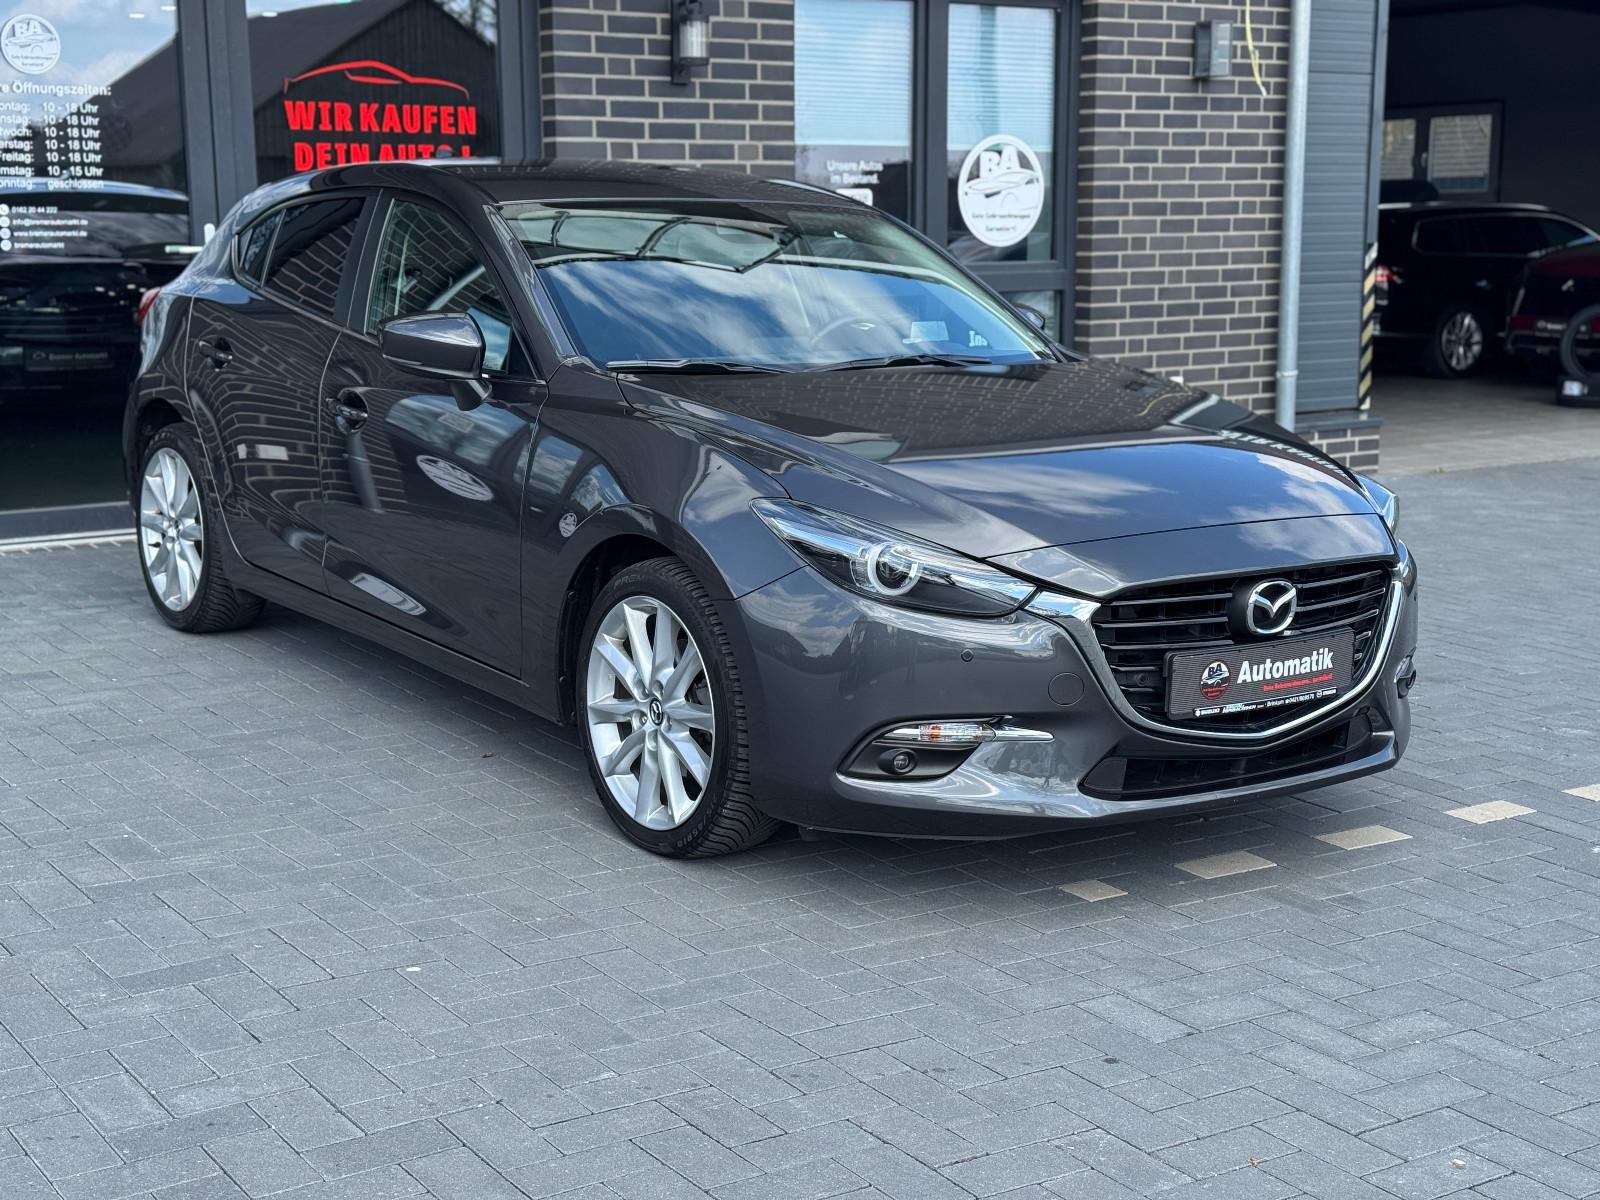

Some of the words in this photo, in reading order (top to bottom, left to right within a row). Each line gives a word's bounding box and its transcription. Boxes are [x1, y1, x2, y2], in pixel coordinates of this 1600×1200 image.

[13, 80, 112, 97] Öffnungszeiten:
[43, 102, 55, 112] 10
[66, 103, 78, 112] 18
[80, 103, 99, 113] Uhr
[44, 115, 56, 124] 10
[66, 115, 79, 125] 18
[80, 115, 100, 125] Uhr
[284, 100, 353, 132] WIR
[360, 103, 477, 135] KAUFEN
[44, 127, 57, 137] 10
[67, 128, 79, 138] 18
[81, 128, 101, 138] Uhr
[45, 140, 58, 150] 10
[67, 140, 80, 150] 18
[82, 140, 102, 150] Uhr
[46, 152, 59, 162] 10
[68, 152, 81, 163] 18
[83, 152, 102, 163] Uhr
[294, 142, 370, 172] DEIN
[980, 145, 1020, 178] BA
[48, 165, 60, 176] 10
[70, 166, 83, 177] 15
[84, 166, 104, 177] Uhr
[48, 178, 104, 190] geschlossen
[1208, 664, 1222, 677] BA
[1236, 647, 1334, 684] Automatik
